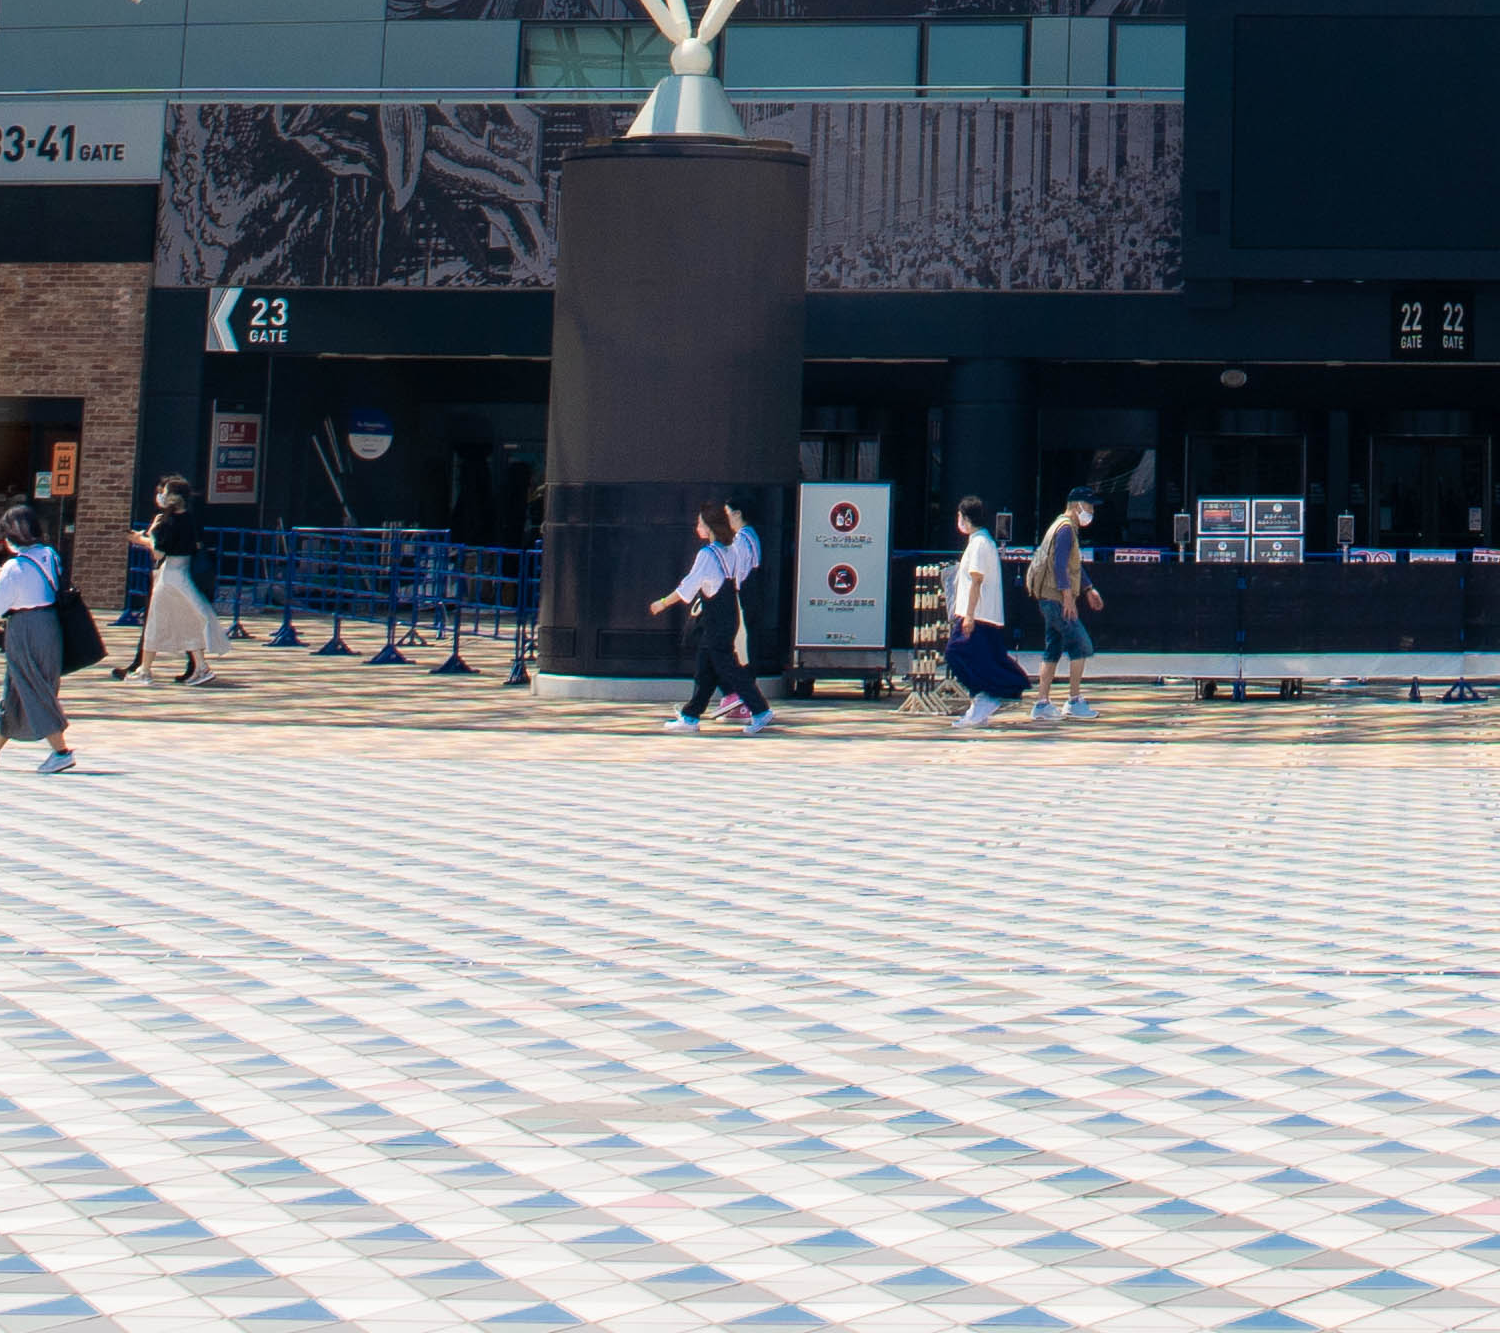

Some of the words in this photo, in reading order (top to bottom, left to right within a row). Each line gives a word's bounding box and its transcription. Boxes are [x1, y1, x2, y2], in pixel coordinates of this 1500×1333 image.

[79, 143, 126, 162] GATE
[250, 298, 289, 326] 23
[1401, 302, 1422, 332] 22
[1443, 302, 1464, 332] 22
[249, 329, 289, 343] GATE
[1401, 334, 1423, 349] GATE
[1443, 334, 1465, 349] GATE
[57, 454, 71, 487] 出口
